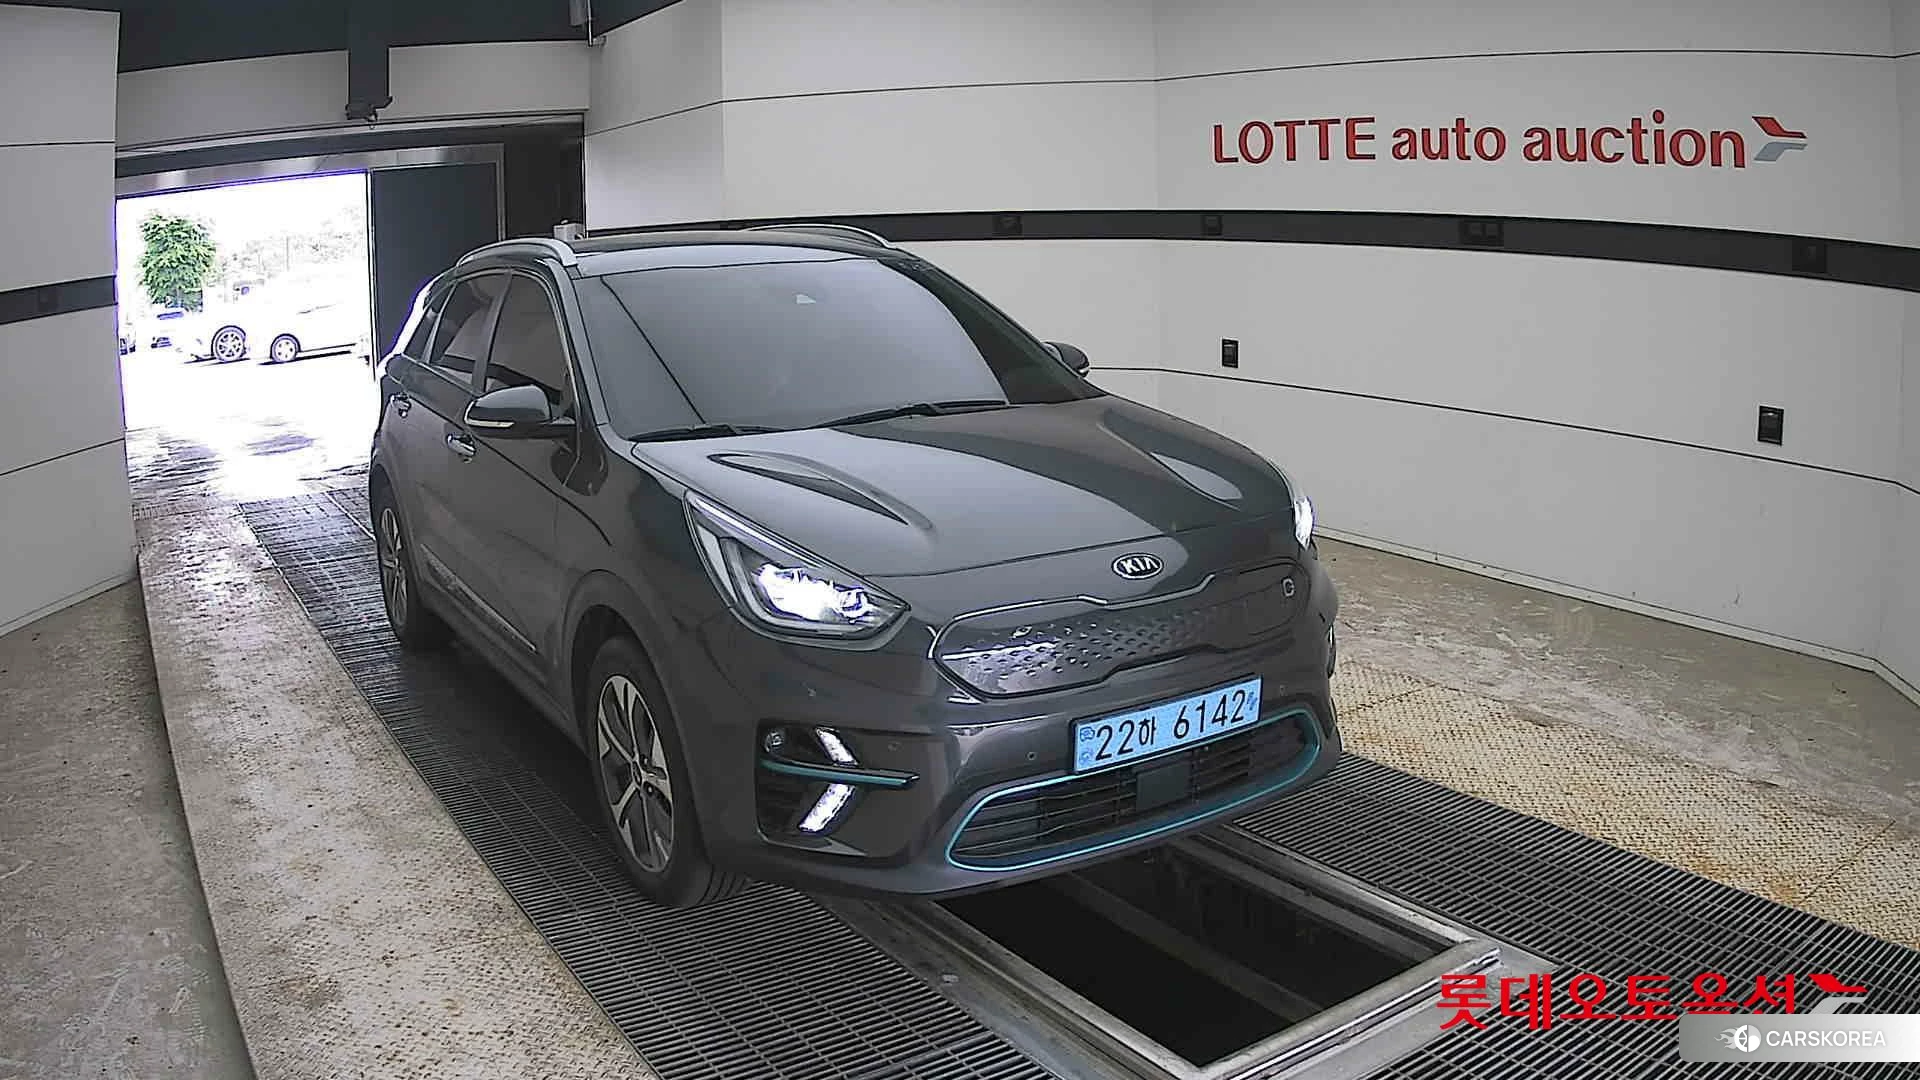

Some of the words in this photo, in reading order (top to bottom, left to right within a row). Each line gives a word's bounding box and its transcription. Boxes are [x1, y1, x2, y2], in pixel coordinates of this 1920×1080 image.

[1212, 116, 1376, 164] LOTTE
[1391, 117, 1507, 162] auto
[1522, 108, 1747, 169] auction
[1118, 554, 1160, 576] KIA
[1094, 715, 1157, 762] 22하
[1172, 688, 1247, 740] 6142
